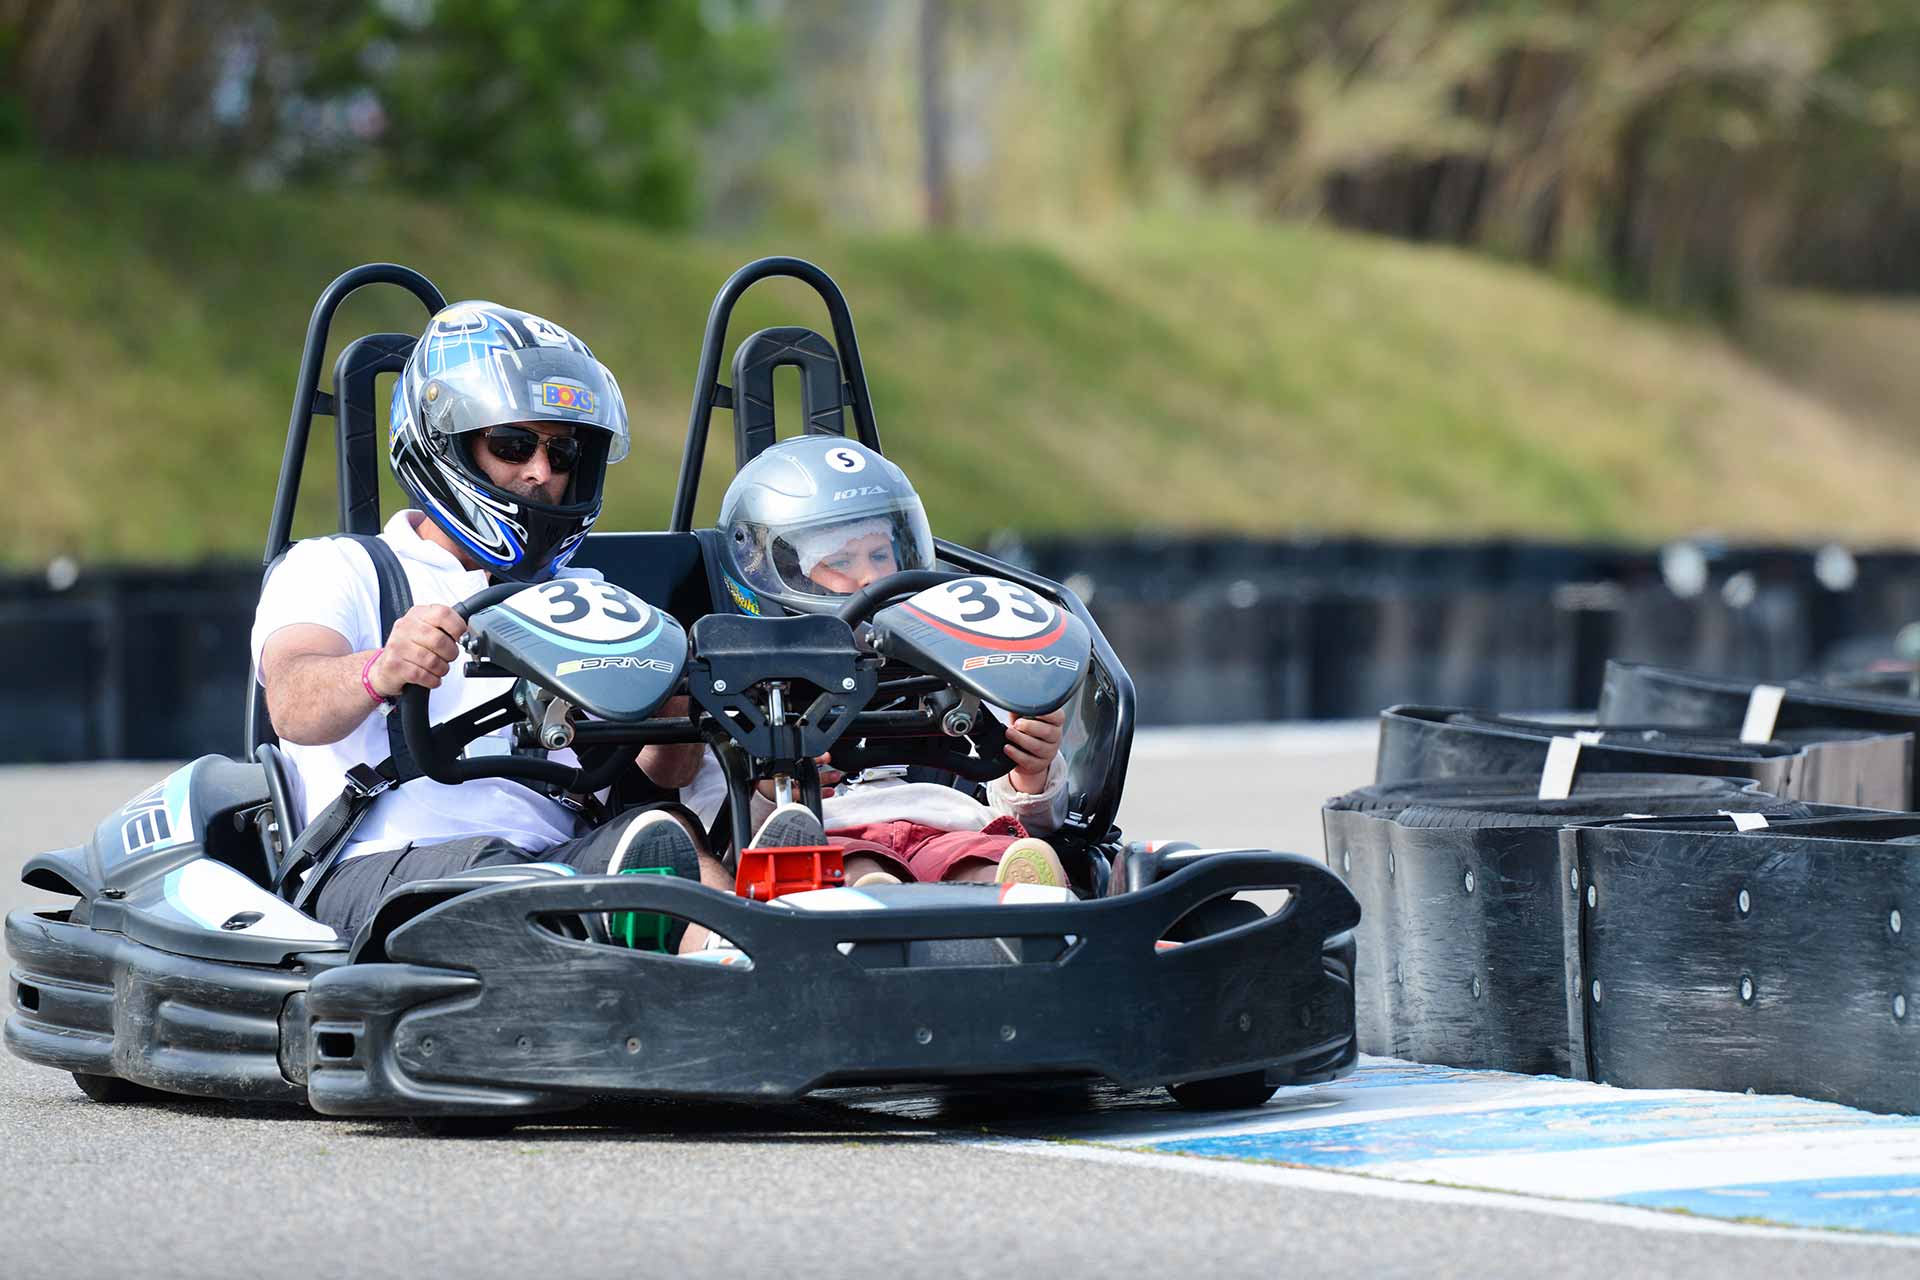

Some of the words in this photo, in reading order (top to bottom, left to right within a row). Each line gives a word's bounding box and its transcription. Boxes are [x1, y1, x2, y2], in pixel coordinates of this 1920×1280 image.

[533, 320, 565, 338] XL
[546, 385, 593, 411] BOXS
[836, 452, 855, 468] S
[833, 485, 889, 502] IOTA
[538, 579, 642, 625] 33
[946, 578, 1050, 624] 33
